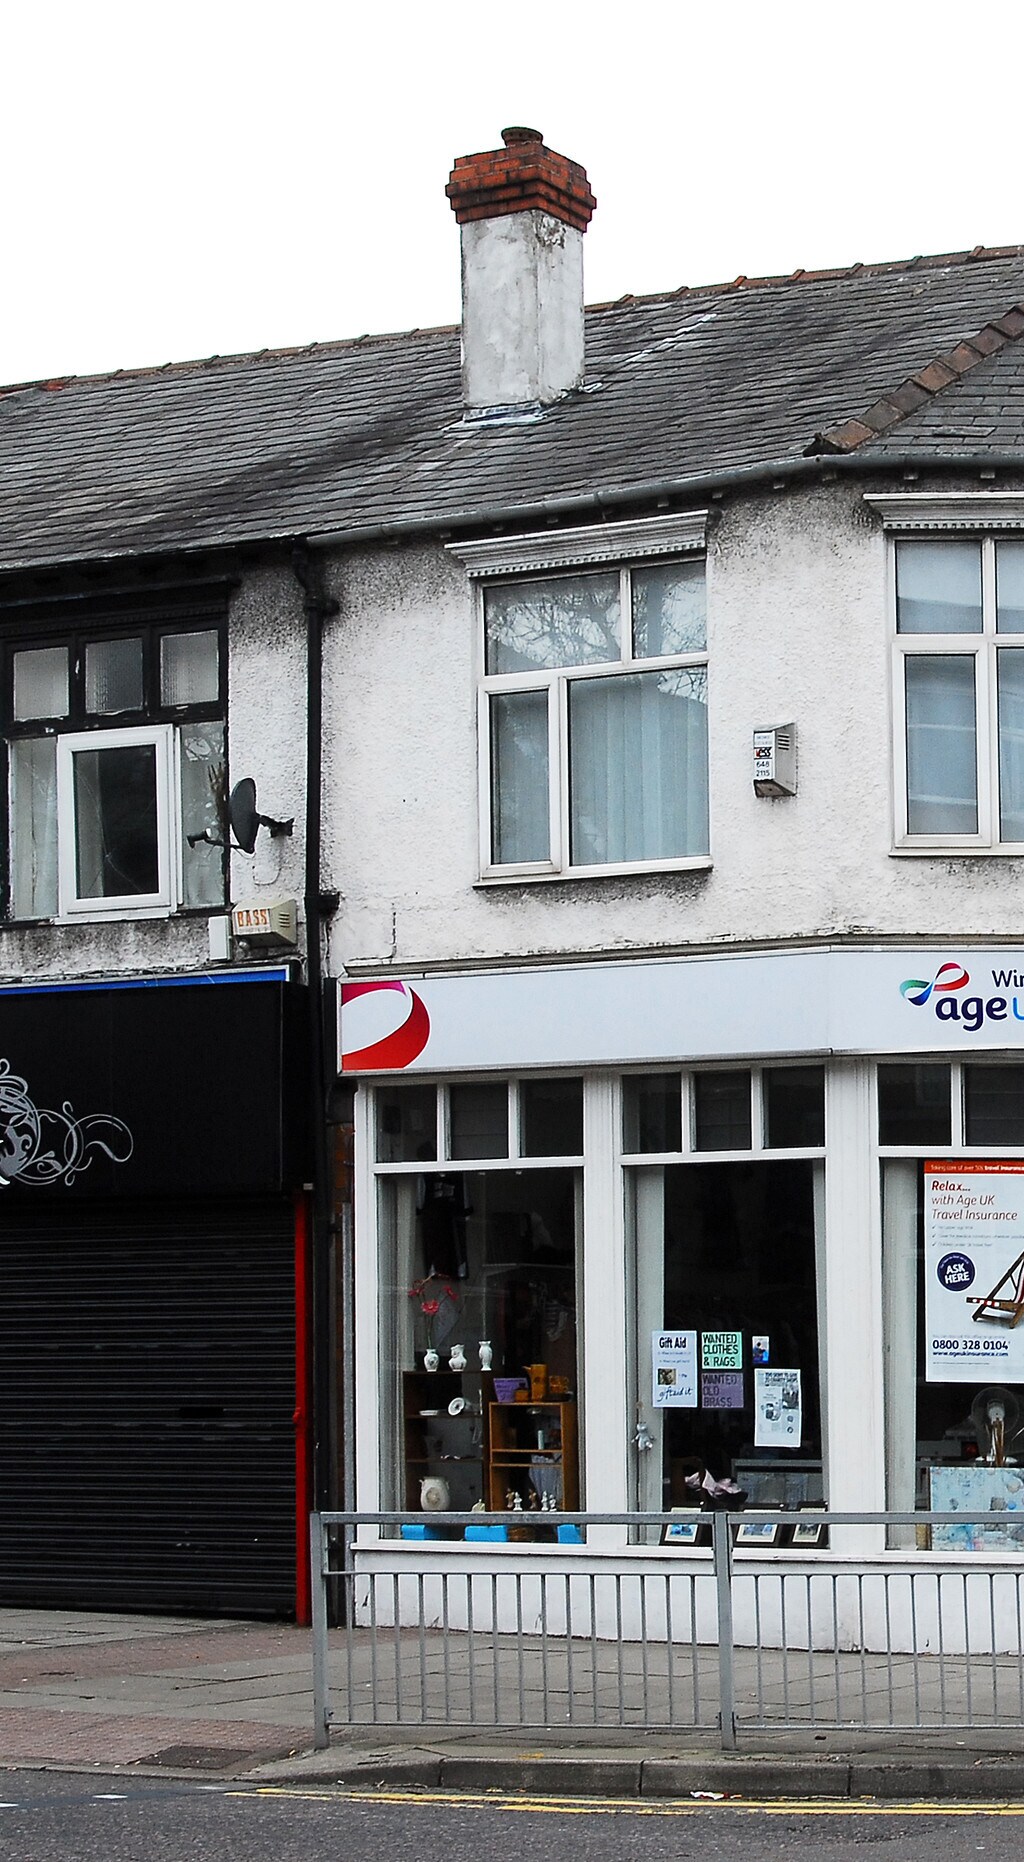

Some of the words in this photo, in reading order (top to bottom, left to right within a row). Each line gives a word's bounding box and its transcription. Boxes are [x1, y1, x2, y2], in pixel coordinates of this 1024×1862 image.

[237, 908, 267, 927] BASS
[935, 997, 1008, 1031] age
[932, 1180, 971, 1191] Relax...
[932, 1195, 955, 1205] with
[957, 1195, 976, 1208] Age
[979, 1195, 995, 1205] UK
[932, 1209, 963, 1220] Travel
[965, 1210, 1017, 1221] Insurance
[946, 1263, 965, 1274] ASK
[944, 1271, 970, 1284] HERE
[659, 1337, 672, 1348] Gift
[674, 1337, 687, 1348] Aid
[703, 1334, 737, 1344] WANTED
[932, 1339, 959, 1350] 0800
[962, 1339, 980, 1350] 328
[983, 1339, 1009, 1350] 0104
[703, 1345, 738, 1354] CLOTHES
[704, 1357, 710, 1366] &
[714, 1357, 736, 1366] RAGS
[703, 1375, 737, 1384] WANTED
[703, 1386, 719, 1395] OLD
[704, 1397, 732, 1407] BRASS
